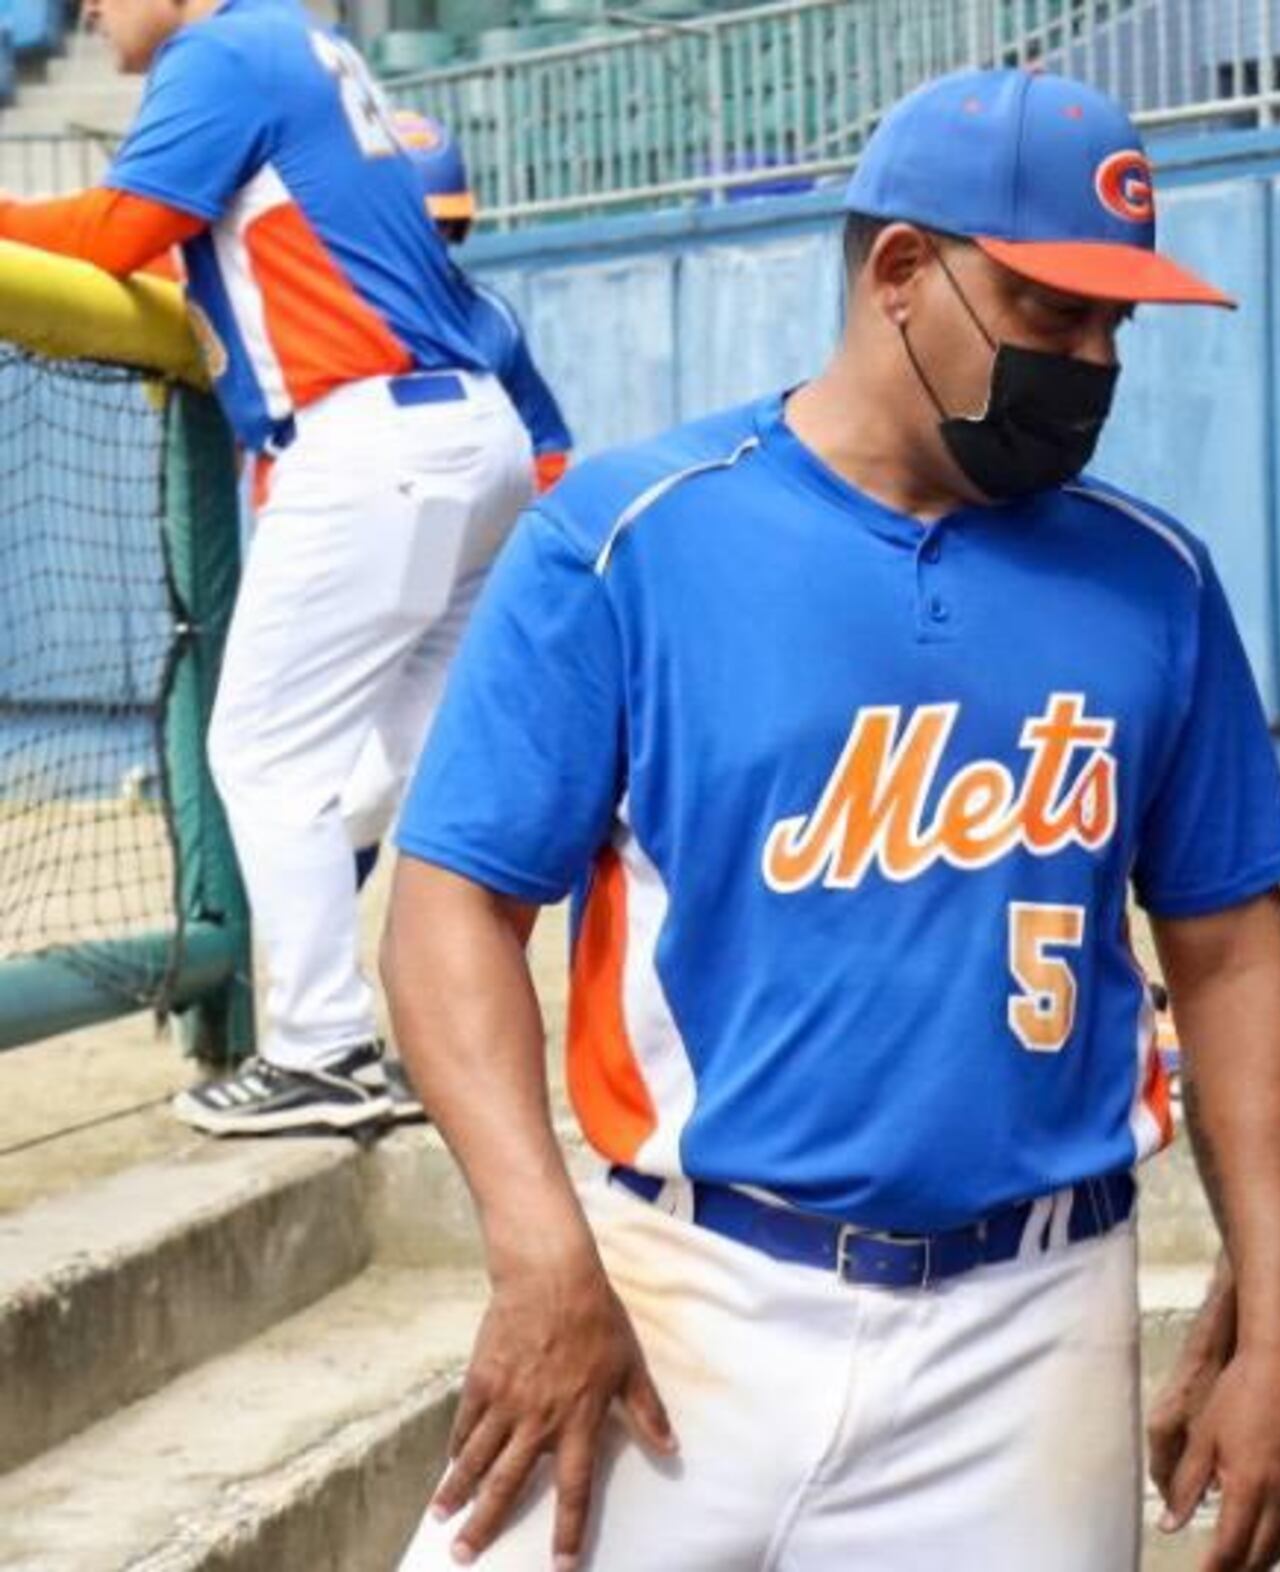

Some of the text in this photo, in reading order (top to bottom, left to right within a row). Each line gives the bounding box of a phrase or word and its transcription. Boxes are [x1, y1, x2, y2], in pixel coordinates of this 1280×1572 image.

[1095, 149, 1153, 223] G
[762, 692, 1117, 893] Mets
[1007, 902, 1084, 1052] 5
